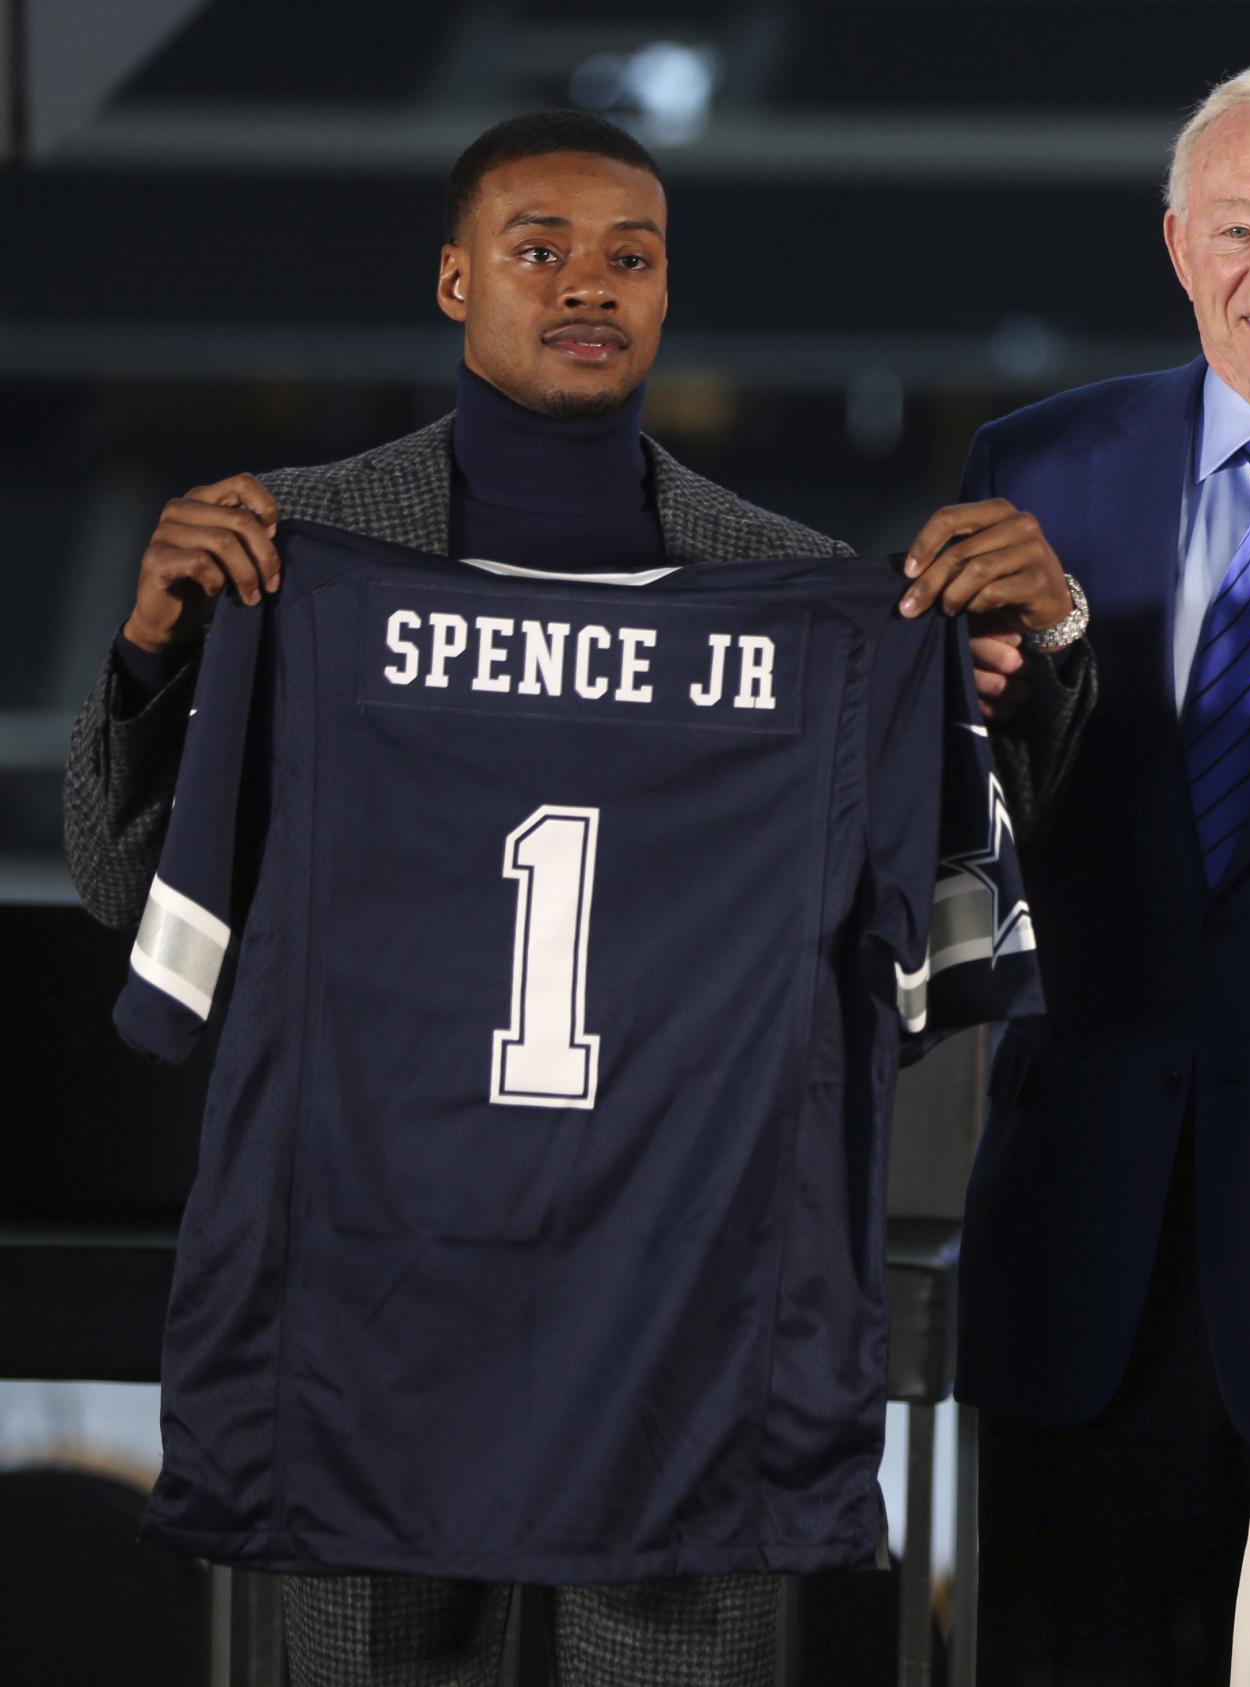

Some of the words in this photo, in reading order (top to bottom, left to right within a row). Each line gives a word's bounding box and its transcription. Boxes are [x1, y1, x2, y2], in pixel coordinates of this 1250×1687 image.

[383, 609, 657, 704] SPENCE
[689, 633, 776, 710] JR
[489, 804, 601, 1110] 1
